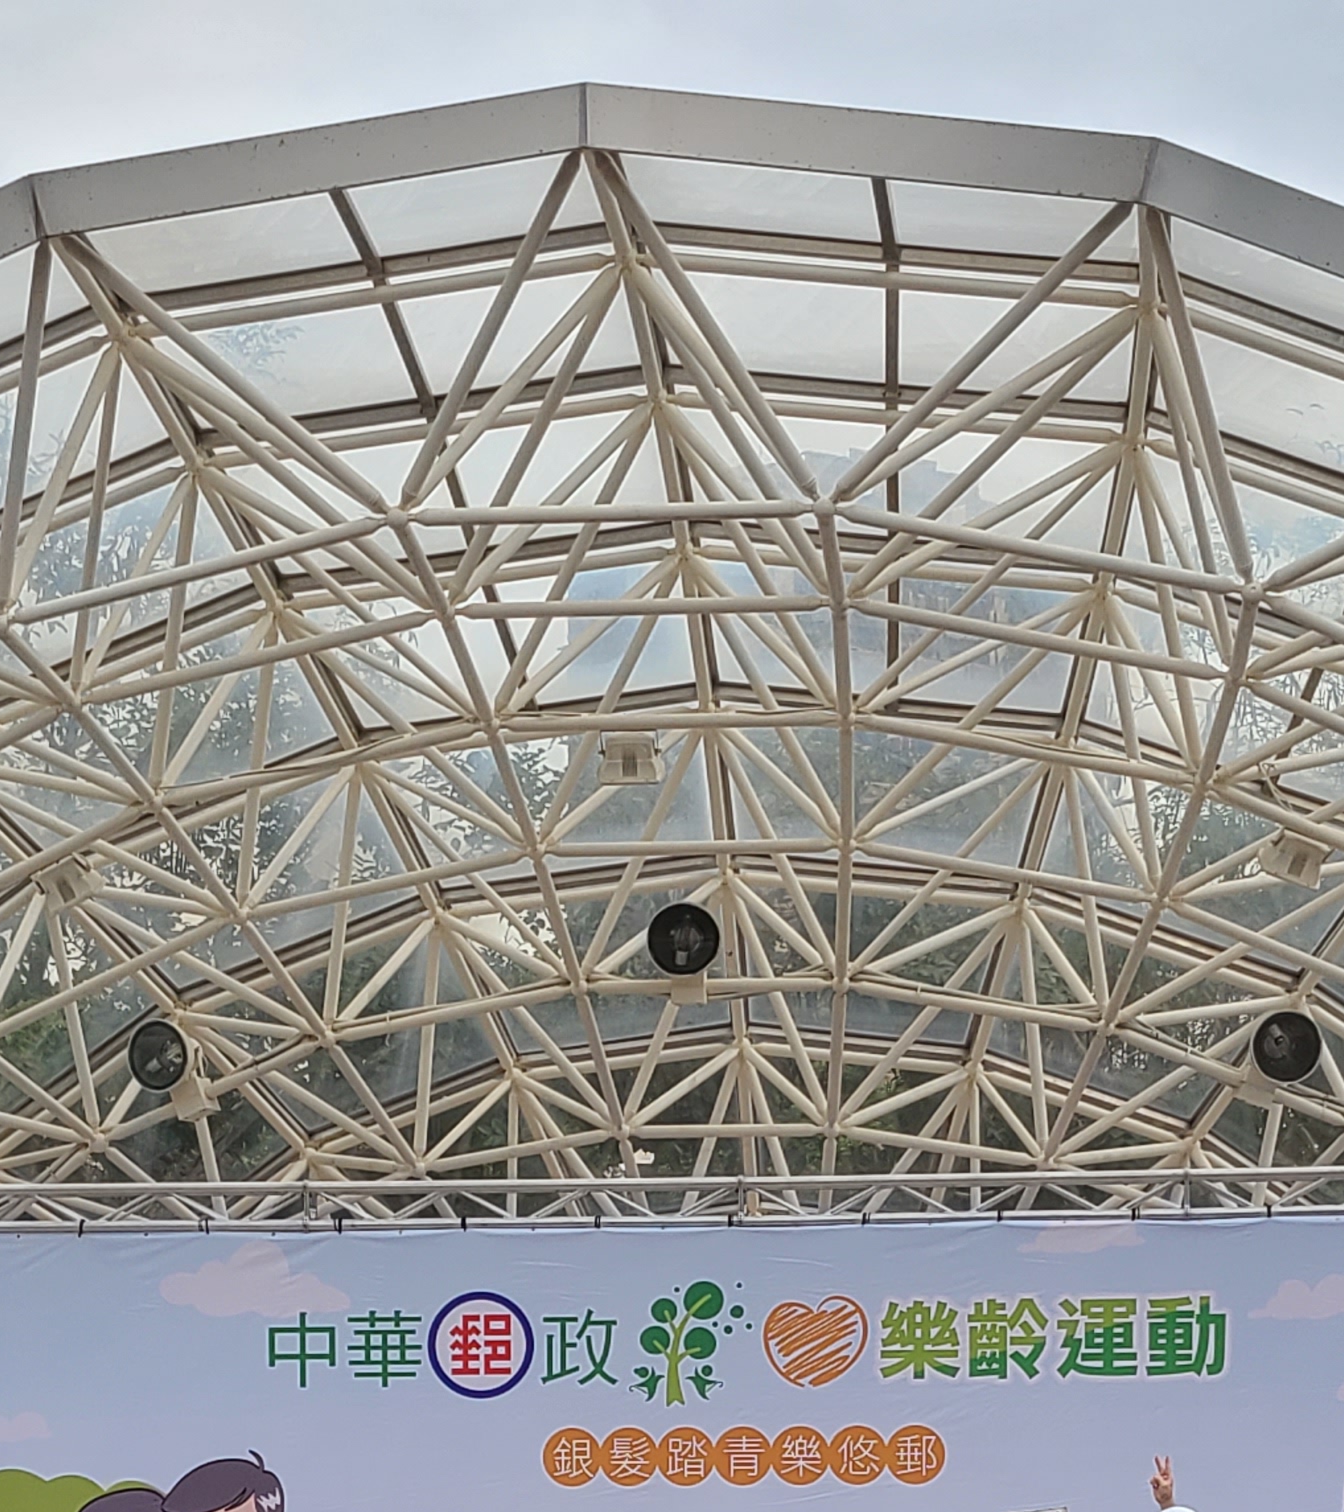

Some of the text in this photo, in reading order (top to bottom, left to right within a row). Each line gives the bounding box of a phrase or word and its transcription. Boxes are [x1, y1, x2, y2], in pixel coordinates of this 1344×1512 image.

[266, 1294, 1228, 1391] 中華郵政 樂齡運動
[550, 1431, 939, 1481] 銀髮踏青樂悠郵
